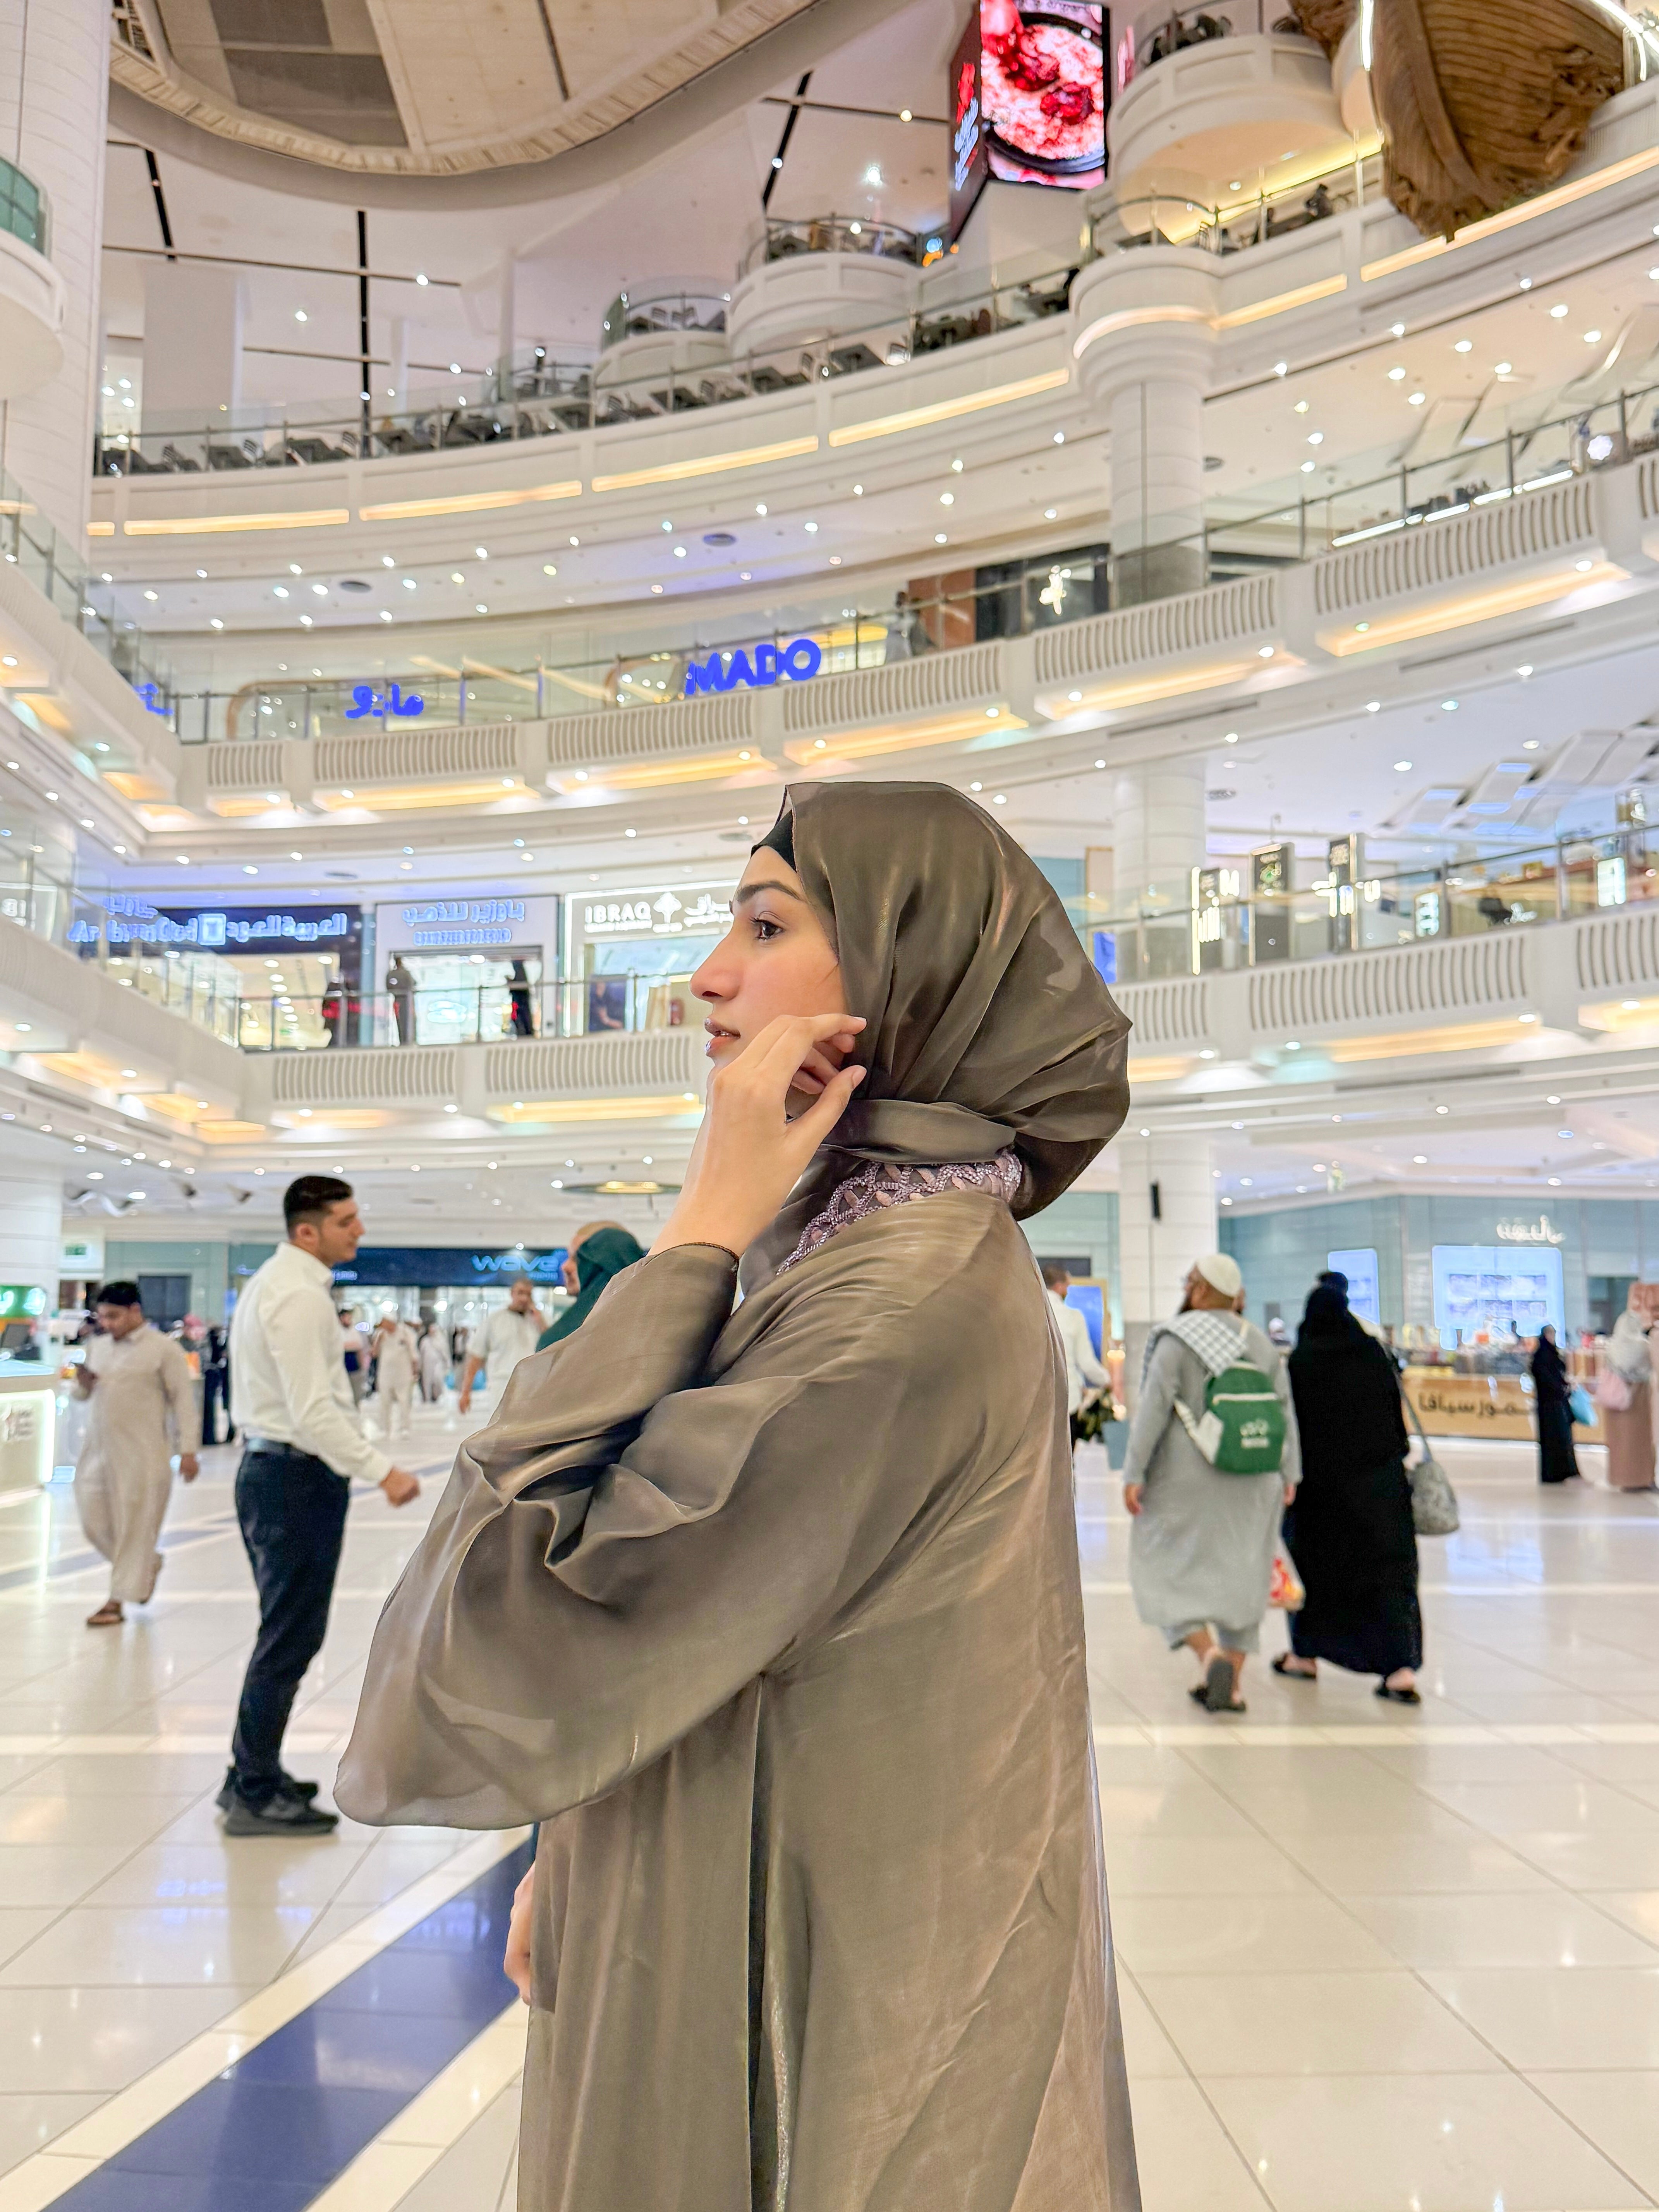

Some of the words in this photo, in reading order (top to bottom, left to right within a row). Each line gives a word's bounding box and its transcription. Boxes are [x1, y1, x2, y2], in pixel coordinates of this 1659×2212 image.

[686, 639, 821, 694] MADO
[585, 902, 651, 923] IBRAQ
[226, 915, 282, 943] العود
